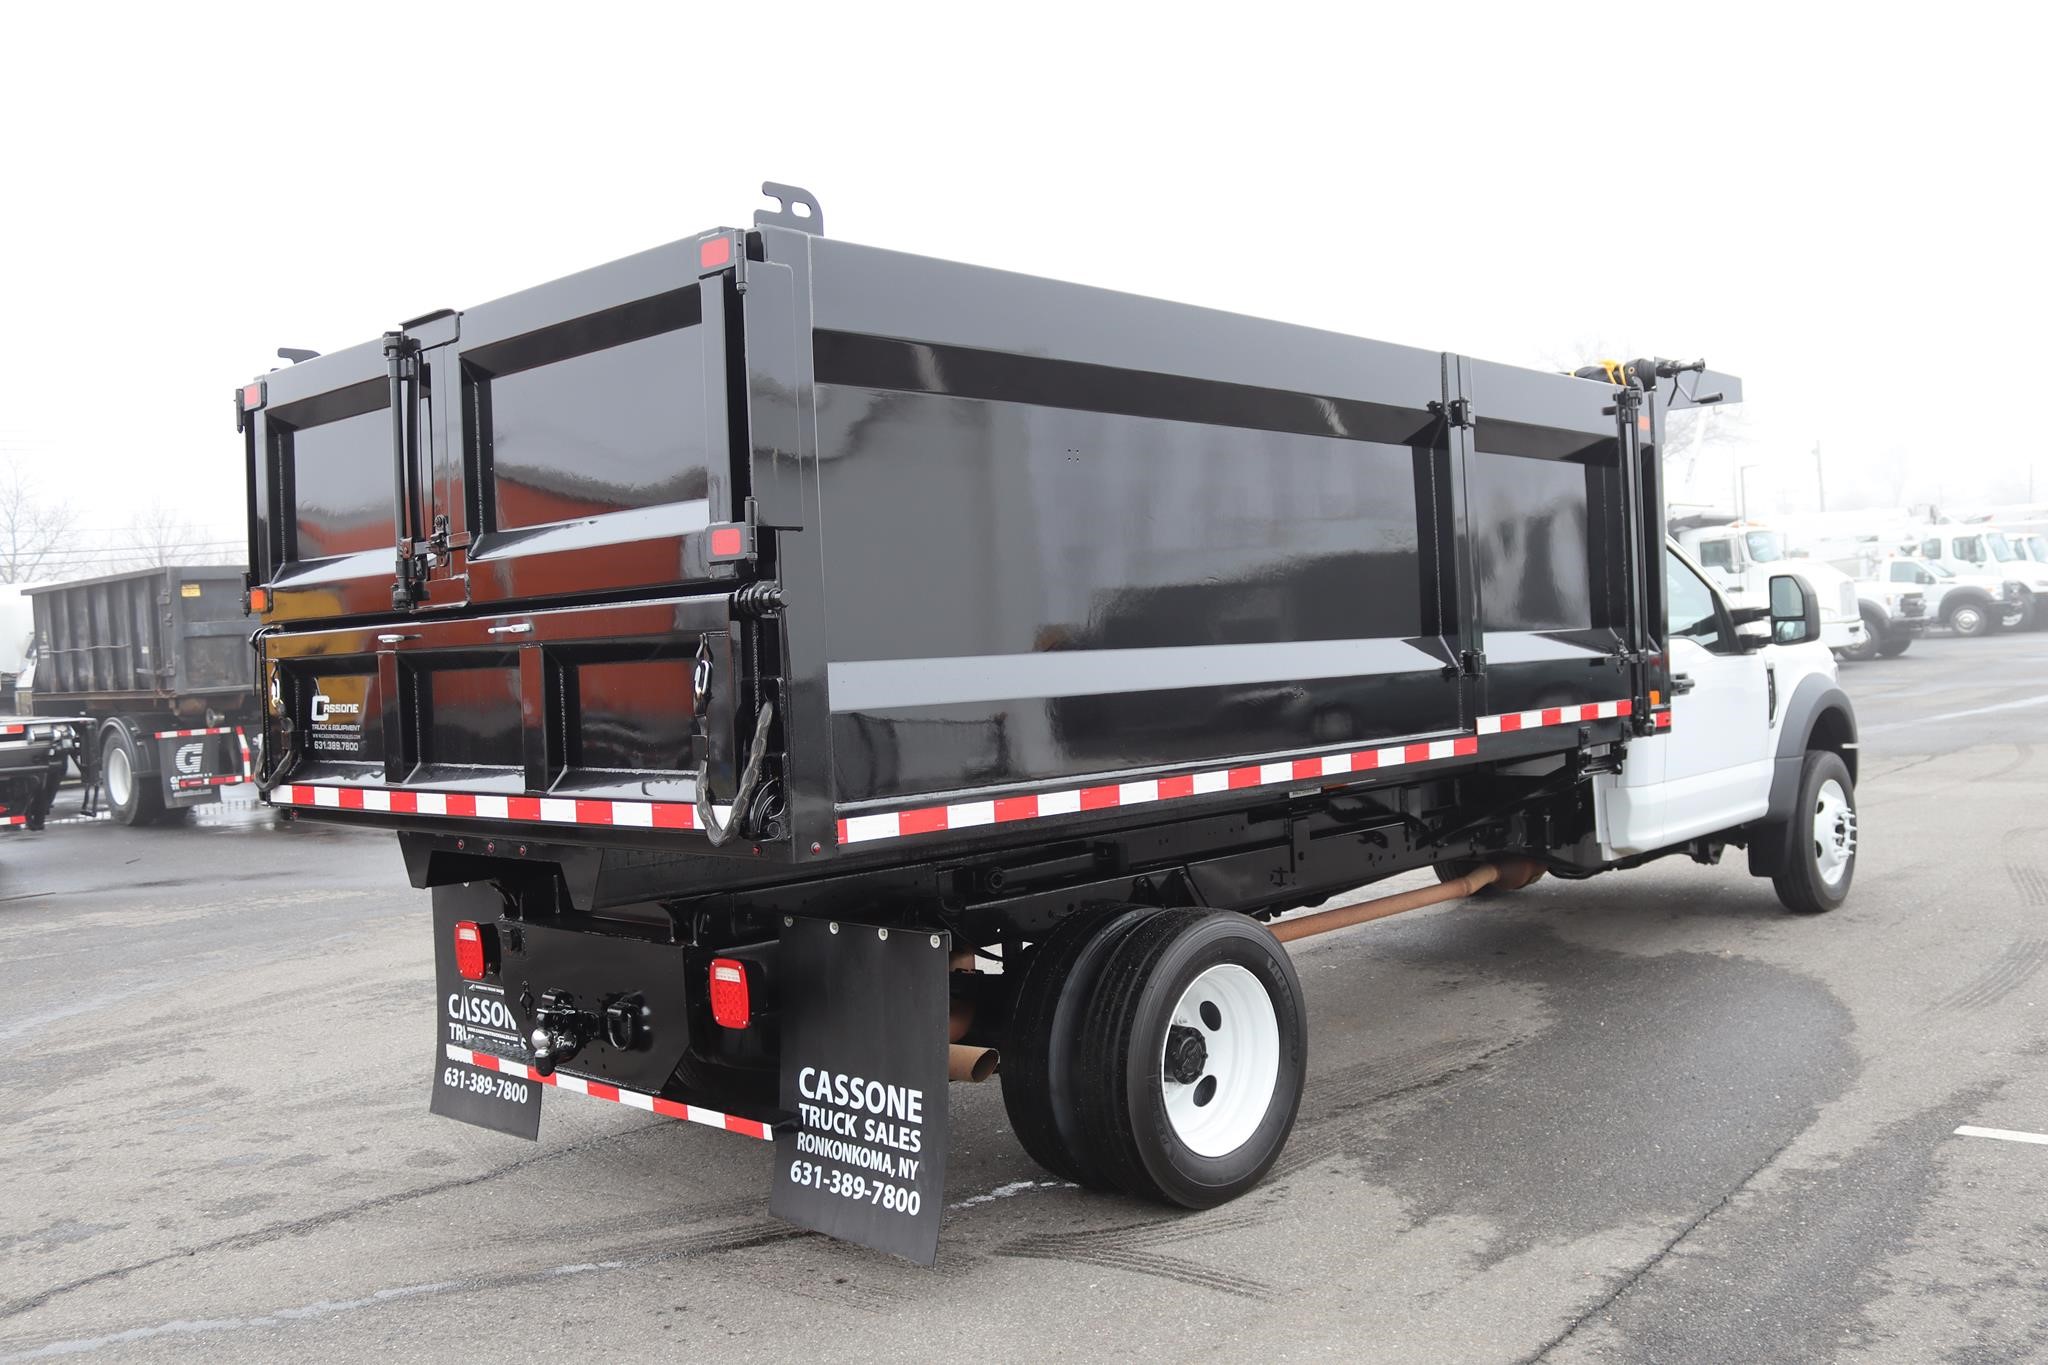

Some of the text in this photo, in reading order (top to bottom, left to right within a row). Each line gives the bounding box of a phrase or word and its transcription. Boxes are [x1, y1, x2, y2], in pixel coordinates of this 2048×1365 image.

[311, 695, 359, 721] CASSONE
[314, 741, 359, 751] 631.389.7800
[332, 724, 361, 732] EQUIPMENT
[175, 743, 204, 773] G
[448, 993, 517, 1031] CASSON
[444, 1067, 528, 1104] 631-389-7800
[798, 1066, 923, 1124] CASSONE
[798, 1102, 922, 1153] TRUCK SALES
[797, 1131, 920, 1181] RONKONKOMA, NY
[790, 1159, 921, 1216] 631-389-7800
